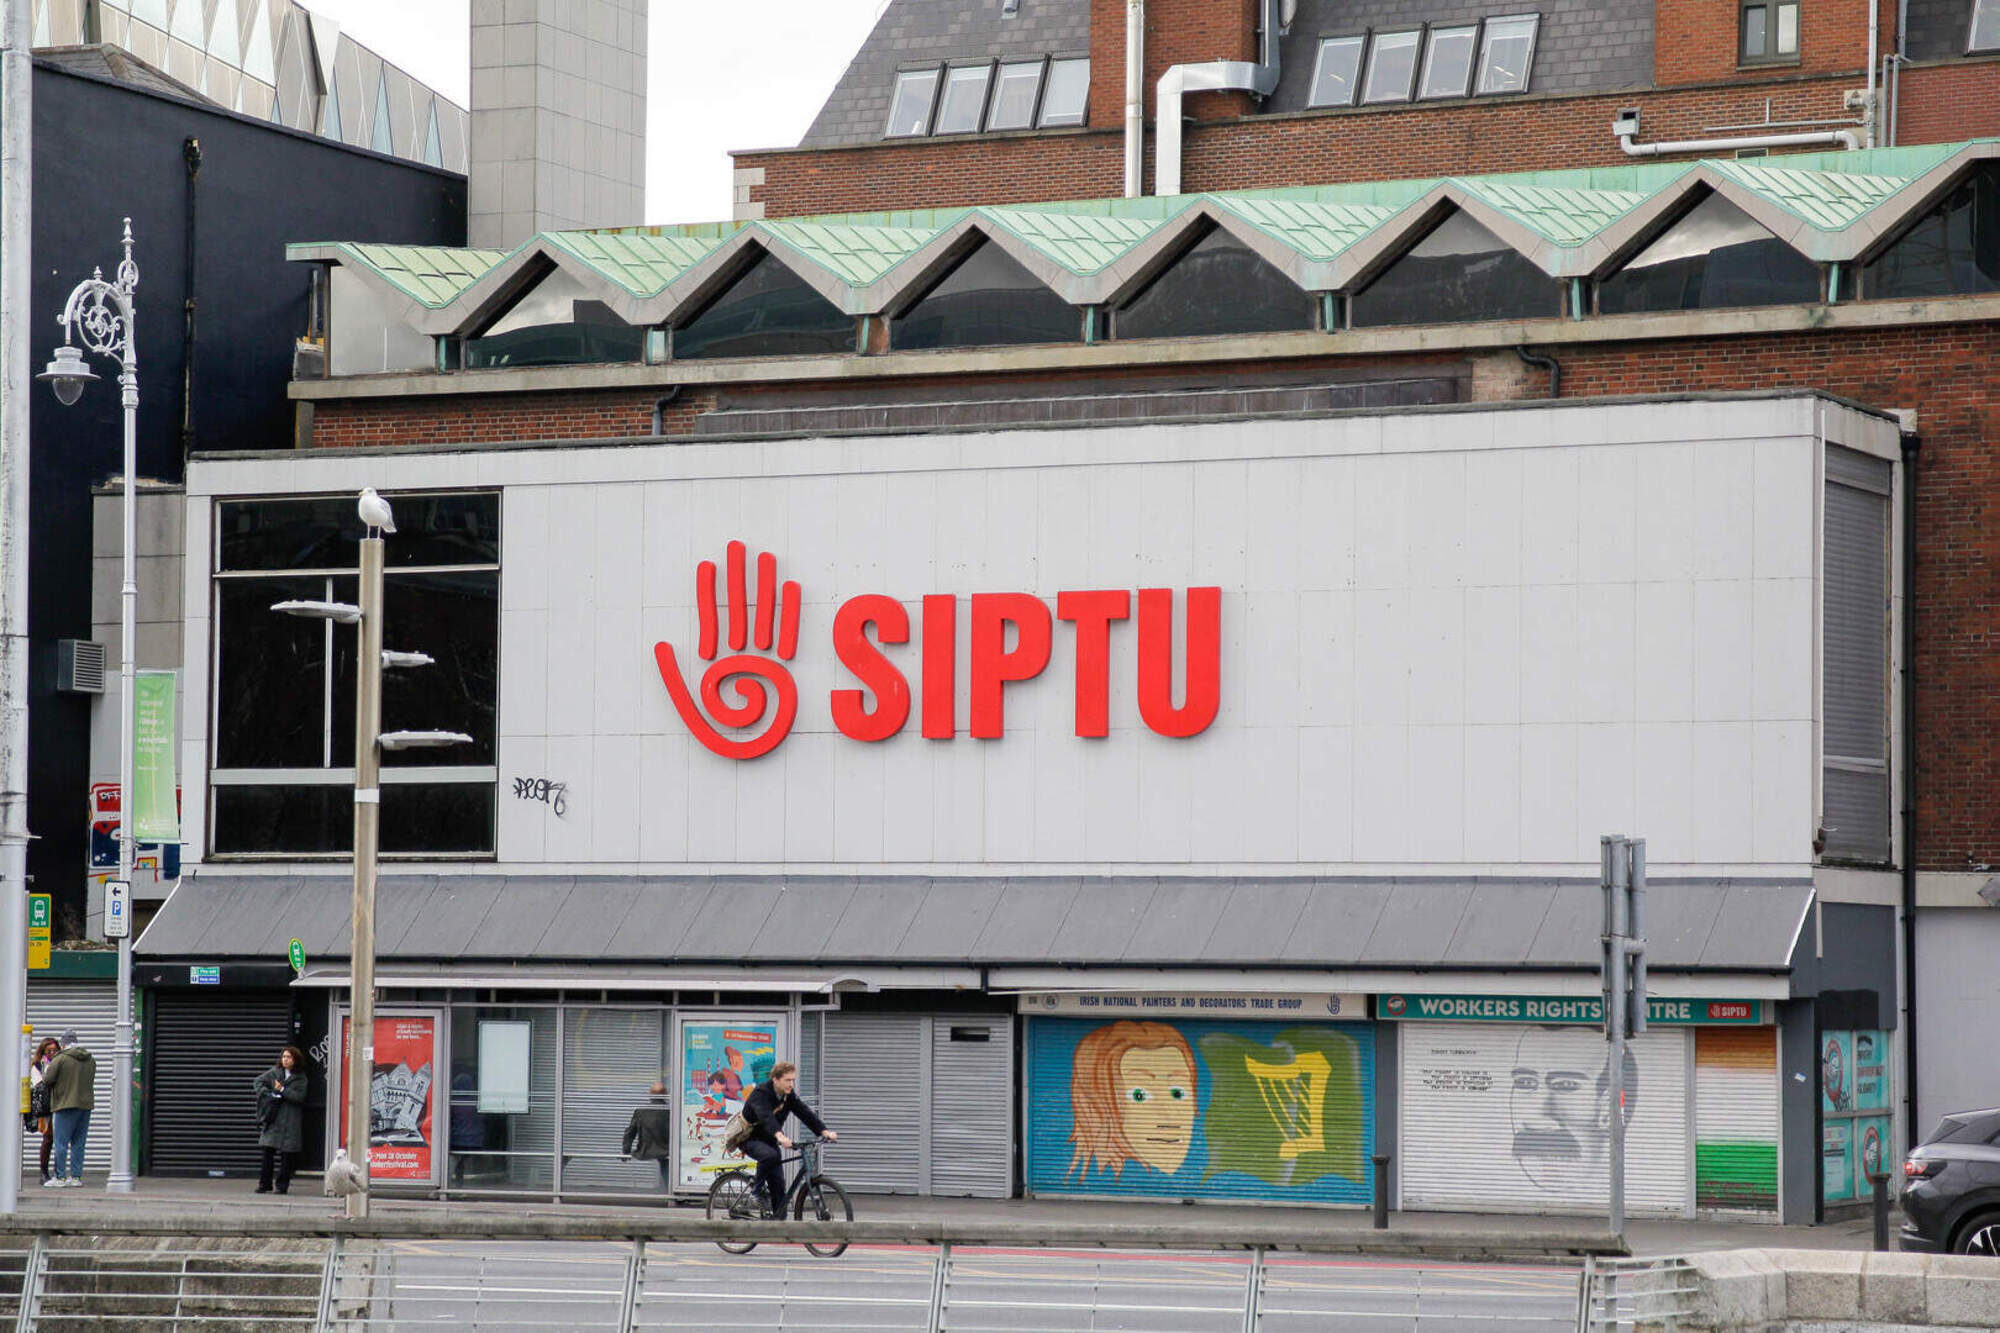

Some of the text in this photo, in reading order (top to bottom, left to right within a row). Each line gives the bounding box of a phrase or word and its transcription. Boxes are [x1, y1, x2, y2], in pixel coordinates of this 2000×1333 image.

[830, 586, 1222, 743] SIPTU
[1079, 996, 1303, 1010] IRISH NATIONAL PAINTERS AND DECORATORS TRADE GROUP
[1419, 998, 1520, 1017] WORKERS
[1526, 1001, 1602, 1019] RIGHTS
[1721, 1007, 1747, 1017] SIPTU
